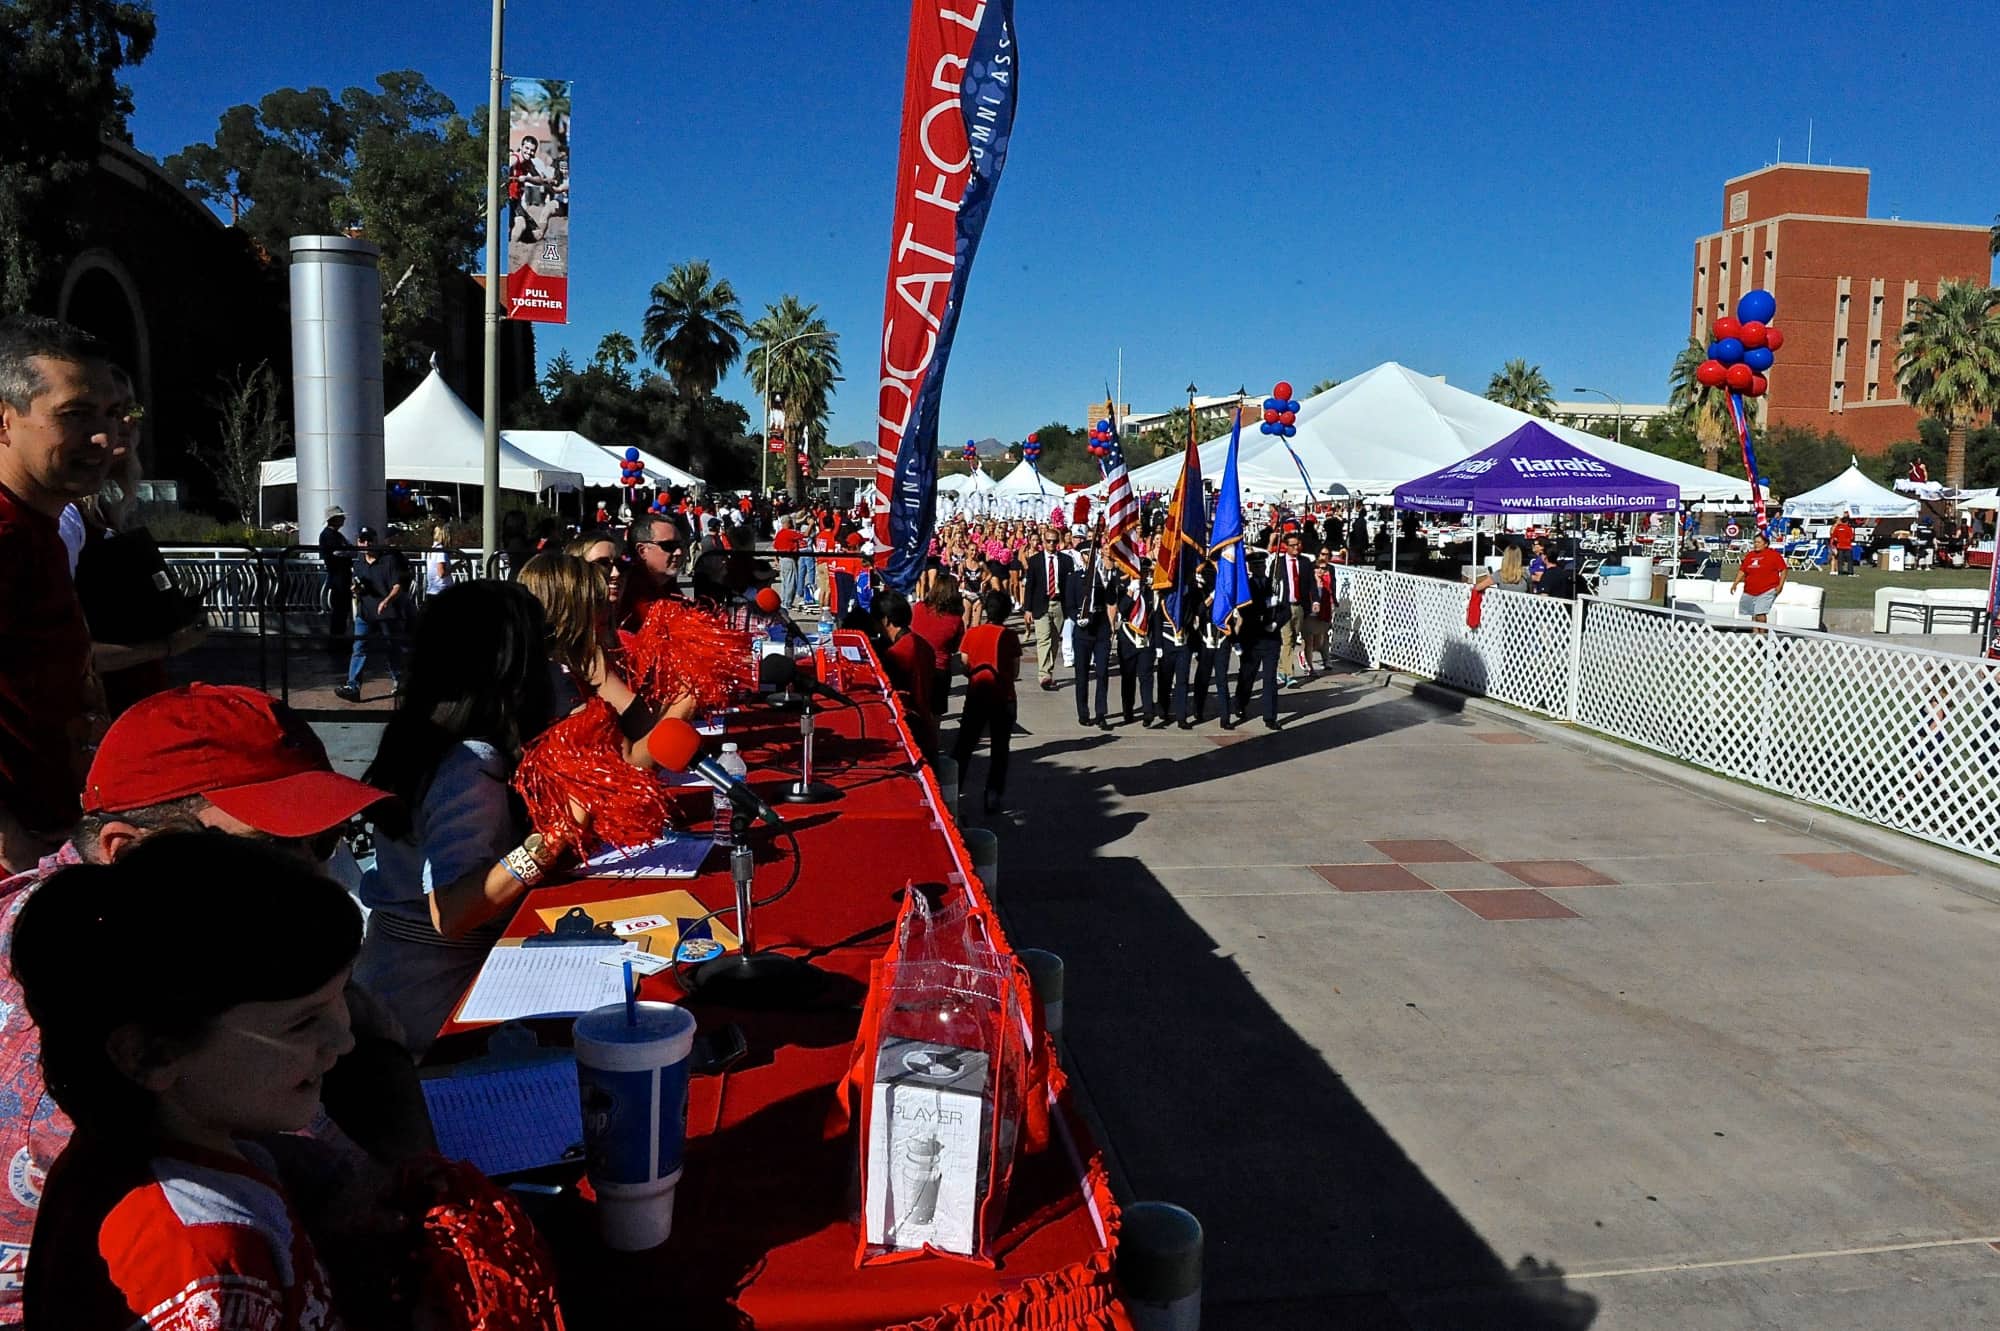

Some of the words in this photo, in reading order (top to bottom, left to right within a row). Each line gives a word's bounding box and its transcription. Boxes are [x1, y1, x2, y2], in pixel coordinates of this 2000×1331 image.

[967, 95, 1001, 186] UMNI
[525, 288, 549, 298] PULL
[511, 298, 563, 309] TOGETHER
[1510, 457, 1606, 472] Harrah's
[1500, 494, 1656, 508] www.harrahsakchin.com
[892, 1105, 964, 1126] PLAYER
